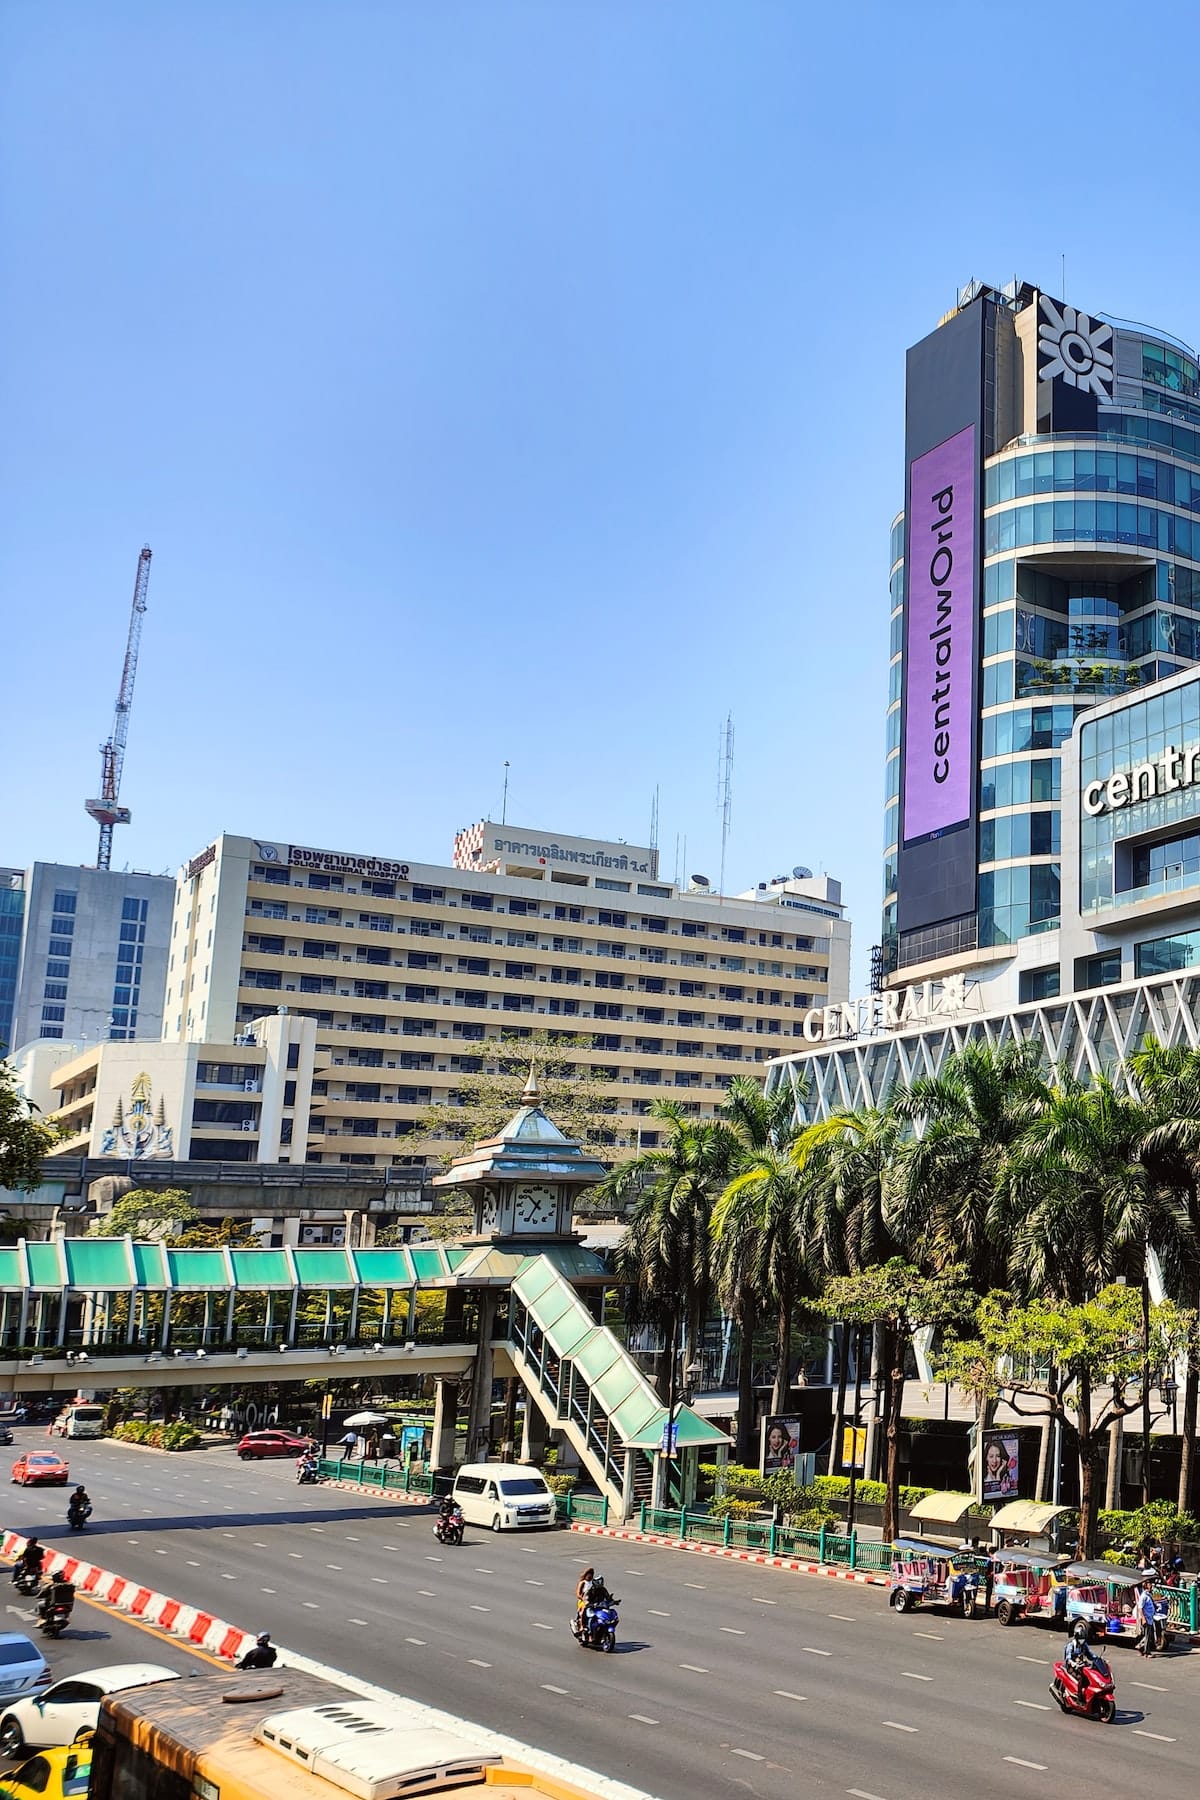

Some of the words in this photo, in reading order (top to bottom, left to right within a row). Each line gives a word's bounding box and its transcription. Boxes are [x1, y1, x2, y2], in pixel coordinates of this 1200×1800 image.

[930, 485, 954, 784] centralwOrld
[287, 845, 410, 874] โรงพยาบาลตำรวจ
[287, 859, 321, 870] POLICE
[323, 864, 365, 875] GENERAL
[367, 869, 409, 881] HOSPITAL
[494, 839, 628, 870] อาคารเฉลิมพระเกียรติ
[803, 980, 940, 1043] CENTRAL
